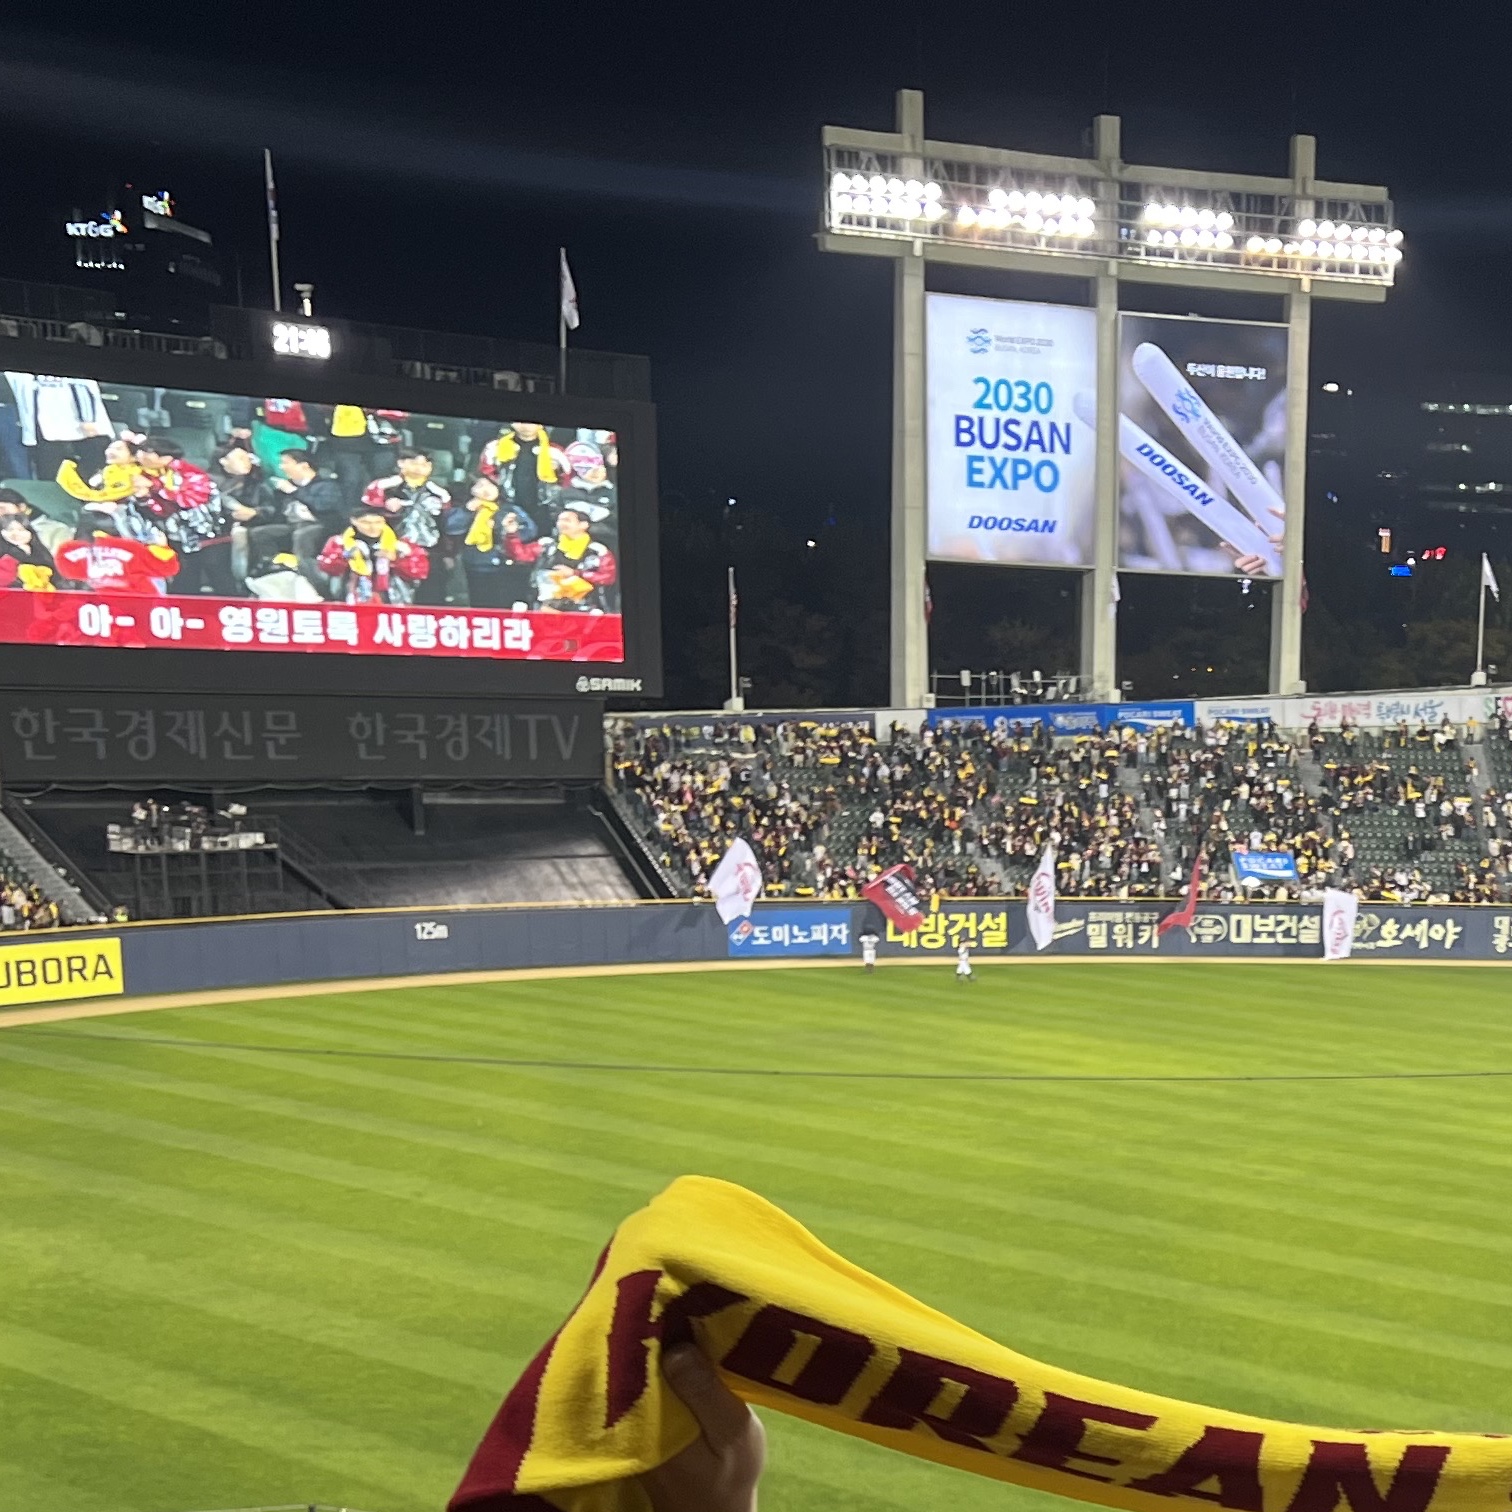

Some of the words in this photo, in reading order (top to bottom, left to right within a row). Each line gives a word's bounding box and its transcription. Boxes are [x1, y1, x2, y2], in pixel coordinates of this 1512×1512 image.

[66, 221, 114, 237] KT&G
[973, 377, 1054, 414] 2030
[954, 414, 1071, 454] BUSAN
[966, 455, 1060, 493] EXPO
[1136, 443, 1214, 507] DOOSAN
[967, 515, 1057, 533] DOOSAN
[78, 603, 134, 638] 아-
[150, 606, 204, 640] 아-
[218, 606, 359, 646] 영원토록
[373, 613, 533, 651] 사랑하리라
[590, 677, 642, 691] SAMIK
[11, 707, 301, 761] 한국경제신문
[347, 711, 580, 761] 한국경제TV
[414, 922, 449, 940] 125m
[751, 922, 850, 946] 도미노피자
[1085, 922, 1160, 949] 밀워키
[1229, 913, 1321, 944] 대보건설
